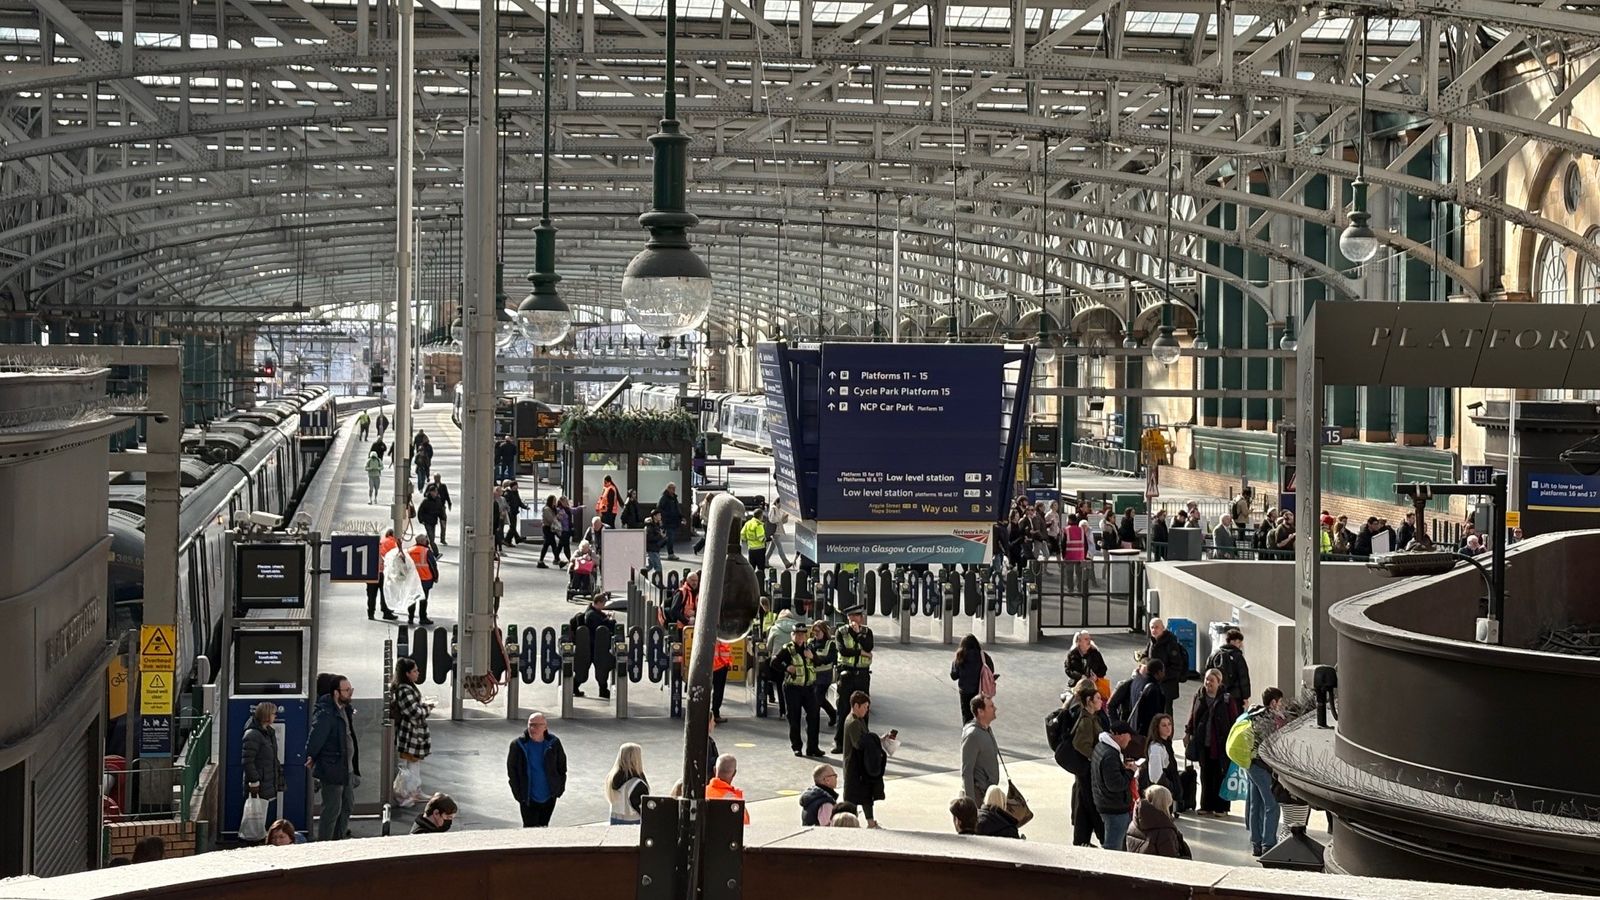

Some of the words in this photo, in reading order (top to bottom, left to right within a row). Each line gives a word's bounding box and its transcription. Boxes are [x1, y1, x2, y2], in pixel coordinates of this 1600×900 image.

[861, 371, 900, 380] Platforms
[903, 372, 910, 380] 11
[920, 372, 928, 380] 15
[854, 387, 878, 396] Cycle
[880, 387, 898, 395] Park
[901, 387, 938, 396] Platform
[703, 400, 712, 409] 13
[860, 403, 878, 411] NCP
[880, 403, 893, 411] Car
[896, 403, 914, 411] Park
[306, 411, 320, 426] 11
[1326, 430, 1340, 443] 15
[905, 473, 924, 482] level
[926, 474, 955, 482] station
[843, 488, 861, 497] Low
[863, 488, 882, 497] level
[884, 488, 913, 497] station
[921, 504, 940, 514] Way
[826, 544, 860, 552] Welcome
[871, 544, 903, 554] Glasgow
[936, 545, 964, 553] Station
[340, 544, 368, 576] 11
